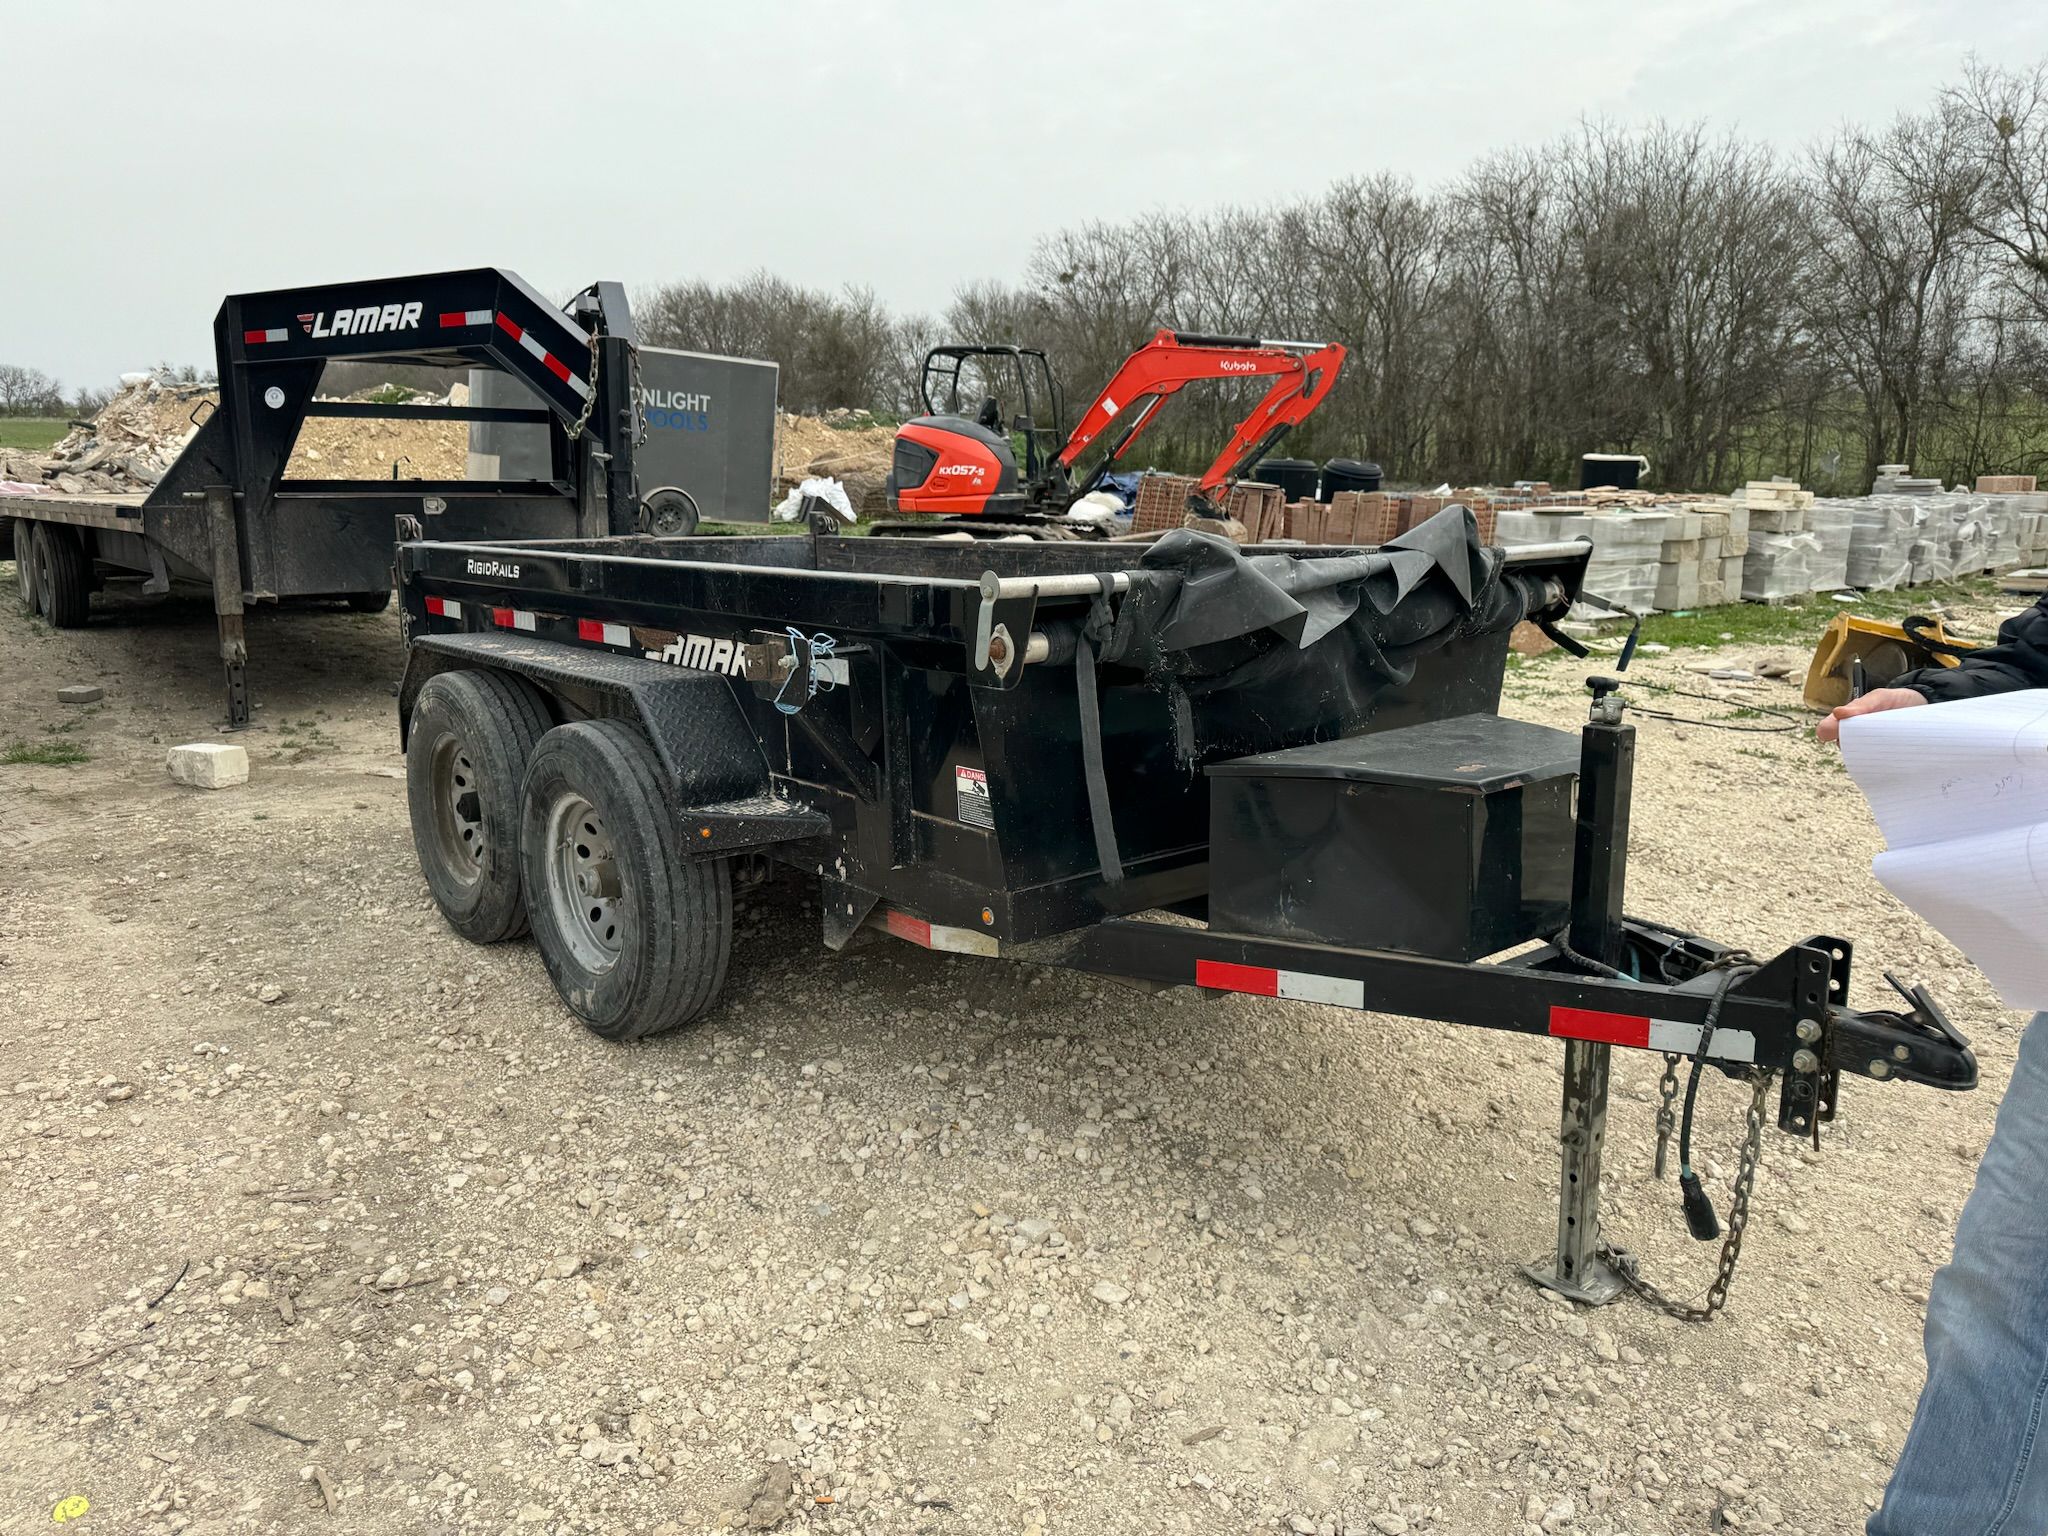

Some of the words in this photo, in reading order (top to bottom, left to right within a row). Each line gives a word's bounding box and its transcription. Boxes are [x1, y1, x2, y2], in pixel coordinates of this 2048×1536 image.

[312, 301, 423, 338] LAMAR
[1220, 360, 1257, 371] Kubota
[644, 634, 749, 679] AMAR
[966, 770, 987, 782] DANG
